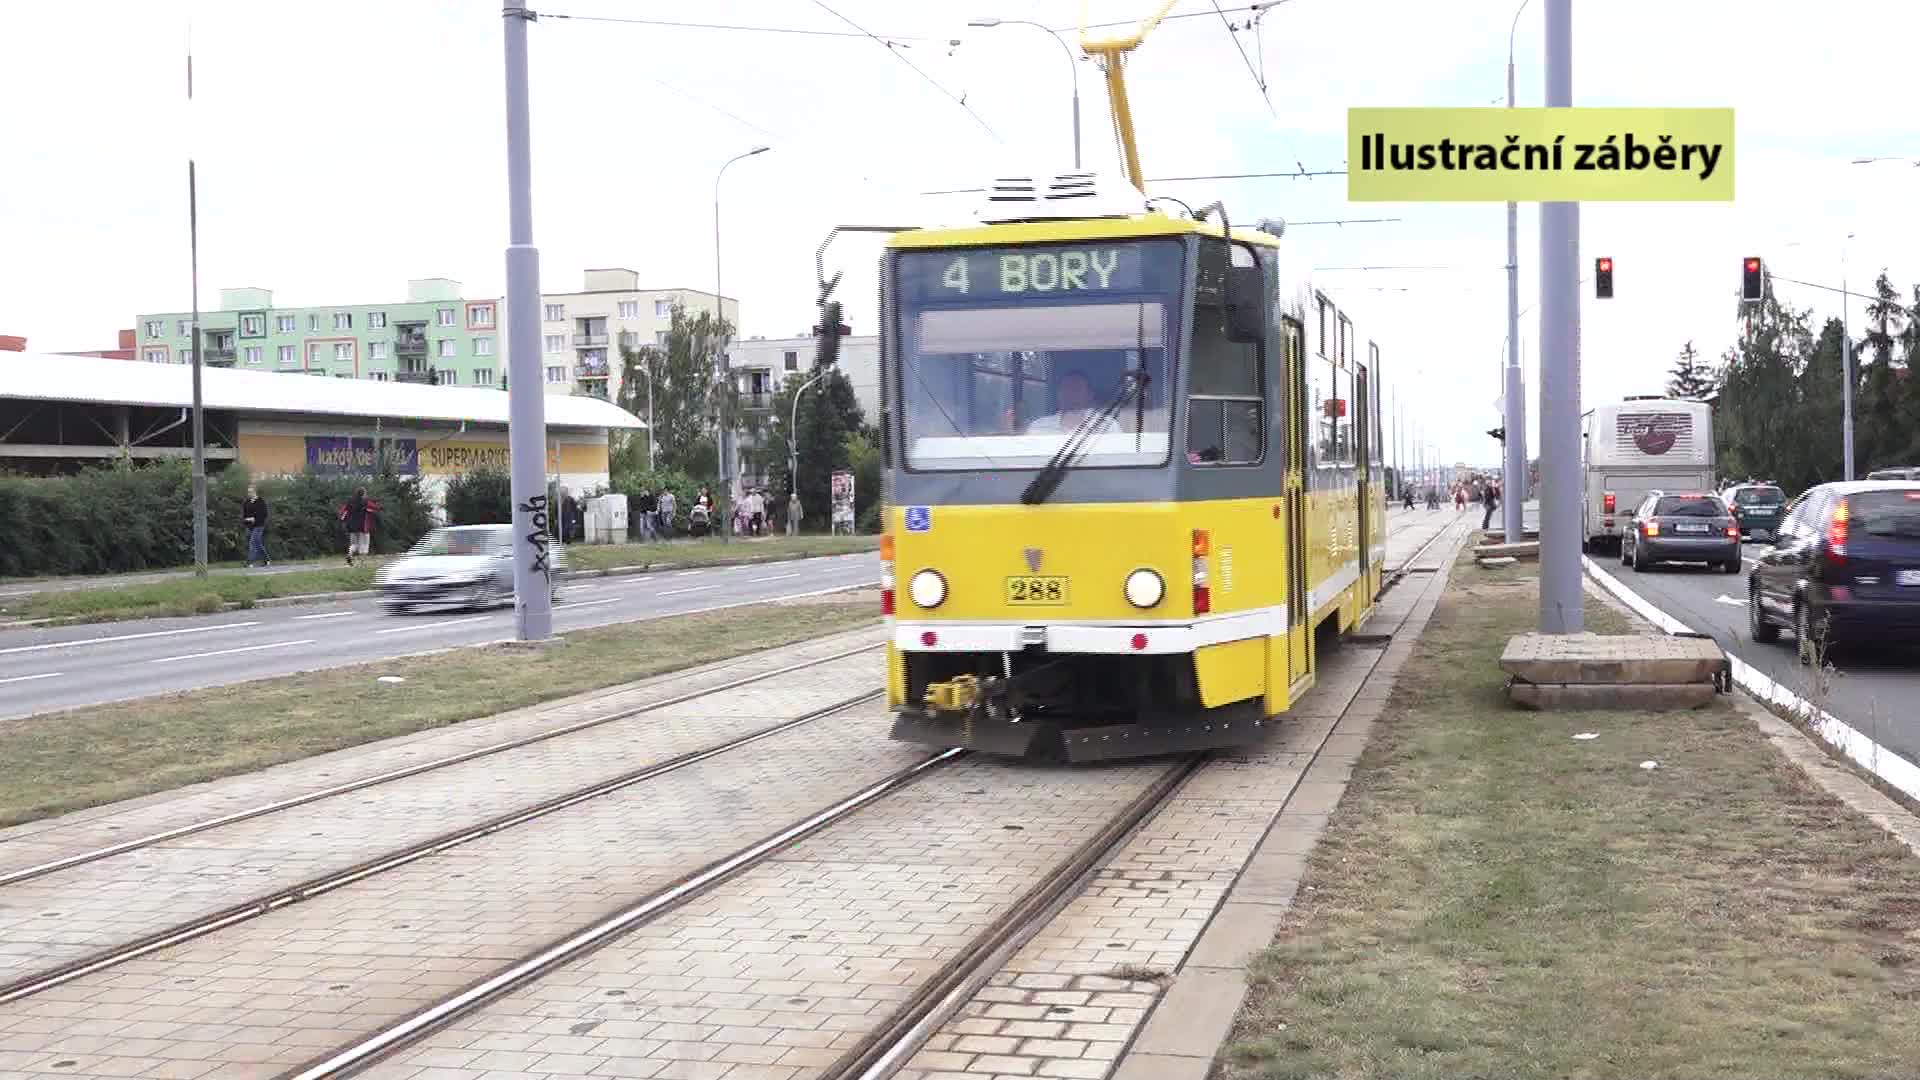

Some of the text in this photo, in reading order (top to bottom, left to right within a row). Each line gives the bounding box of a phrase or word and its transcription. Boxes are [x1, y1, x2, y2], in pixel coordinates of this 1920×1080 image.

[943, 249, 1120, 294] 4 BORY
[1009, 580, 1062, 601] 288
